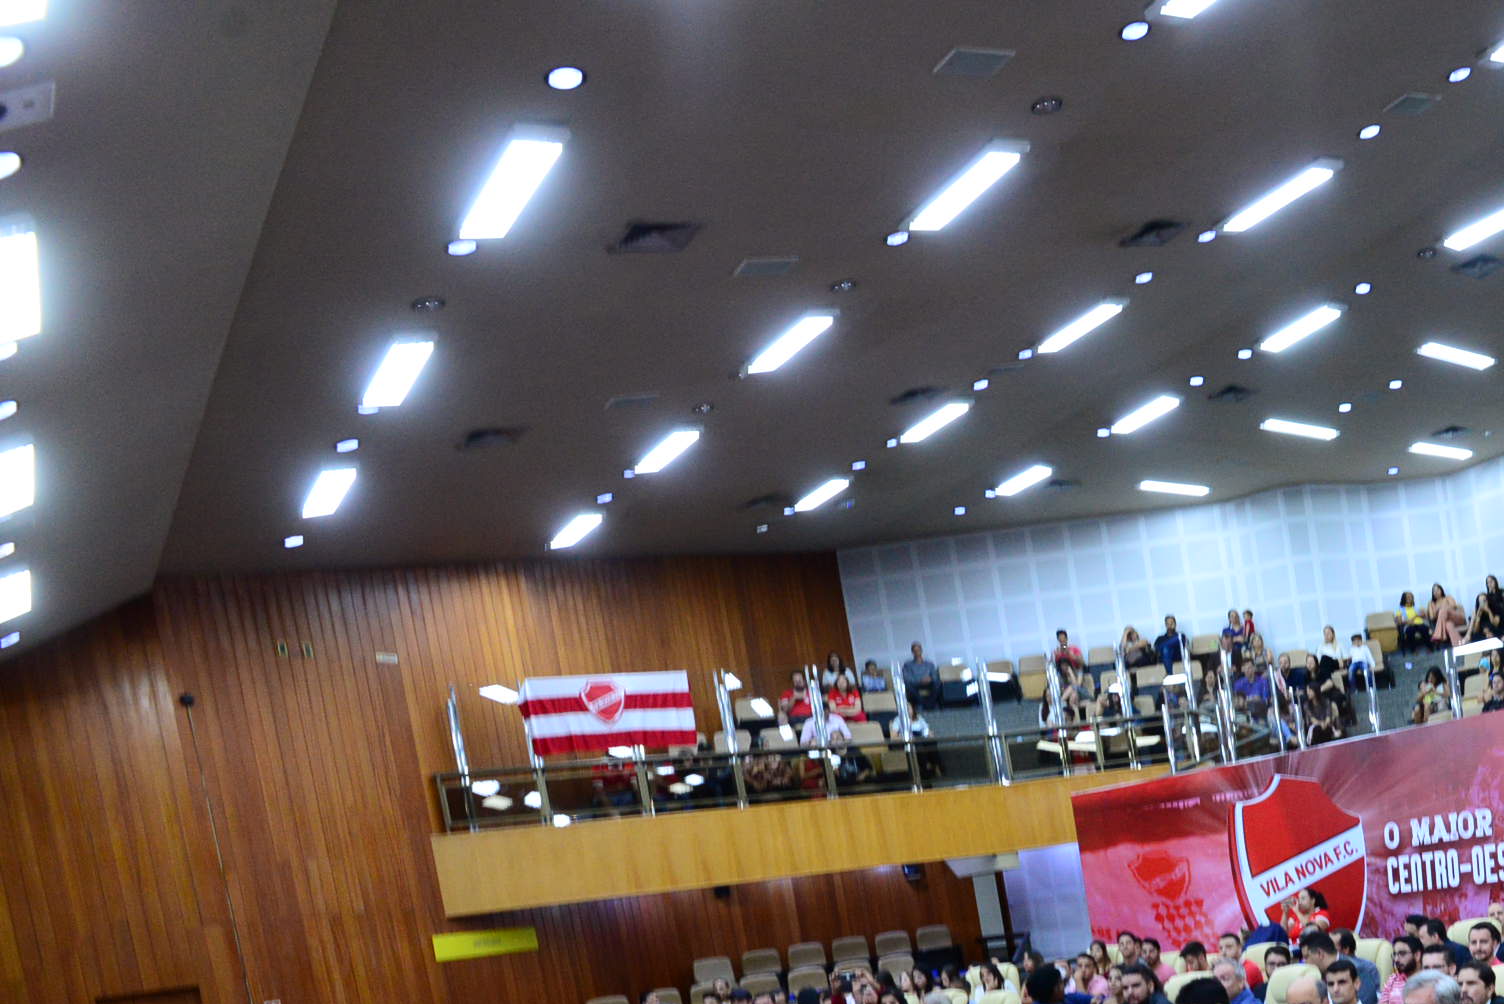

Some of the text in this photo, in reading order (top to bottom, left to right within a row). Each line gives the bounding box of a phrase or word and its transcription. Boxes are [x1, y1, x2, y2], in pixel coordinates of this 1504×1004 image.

[1383, 821, 1401, 849] O
[1410, 807, 1494, 847] MAIOR
[1259, 840, 1359, 898] VILA NOVA F.C.
